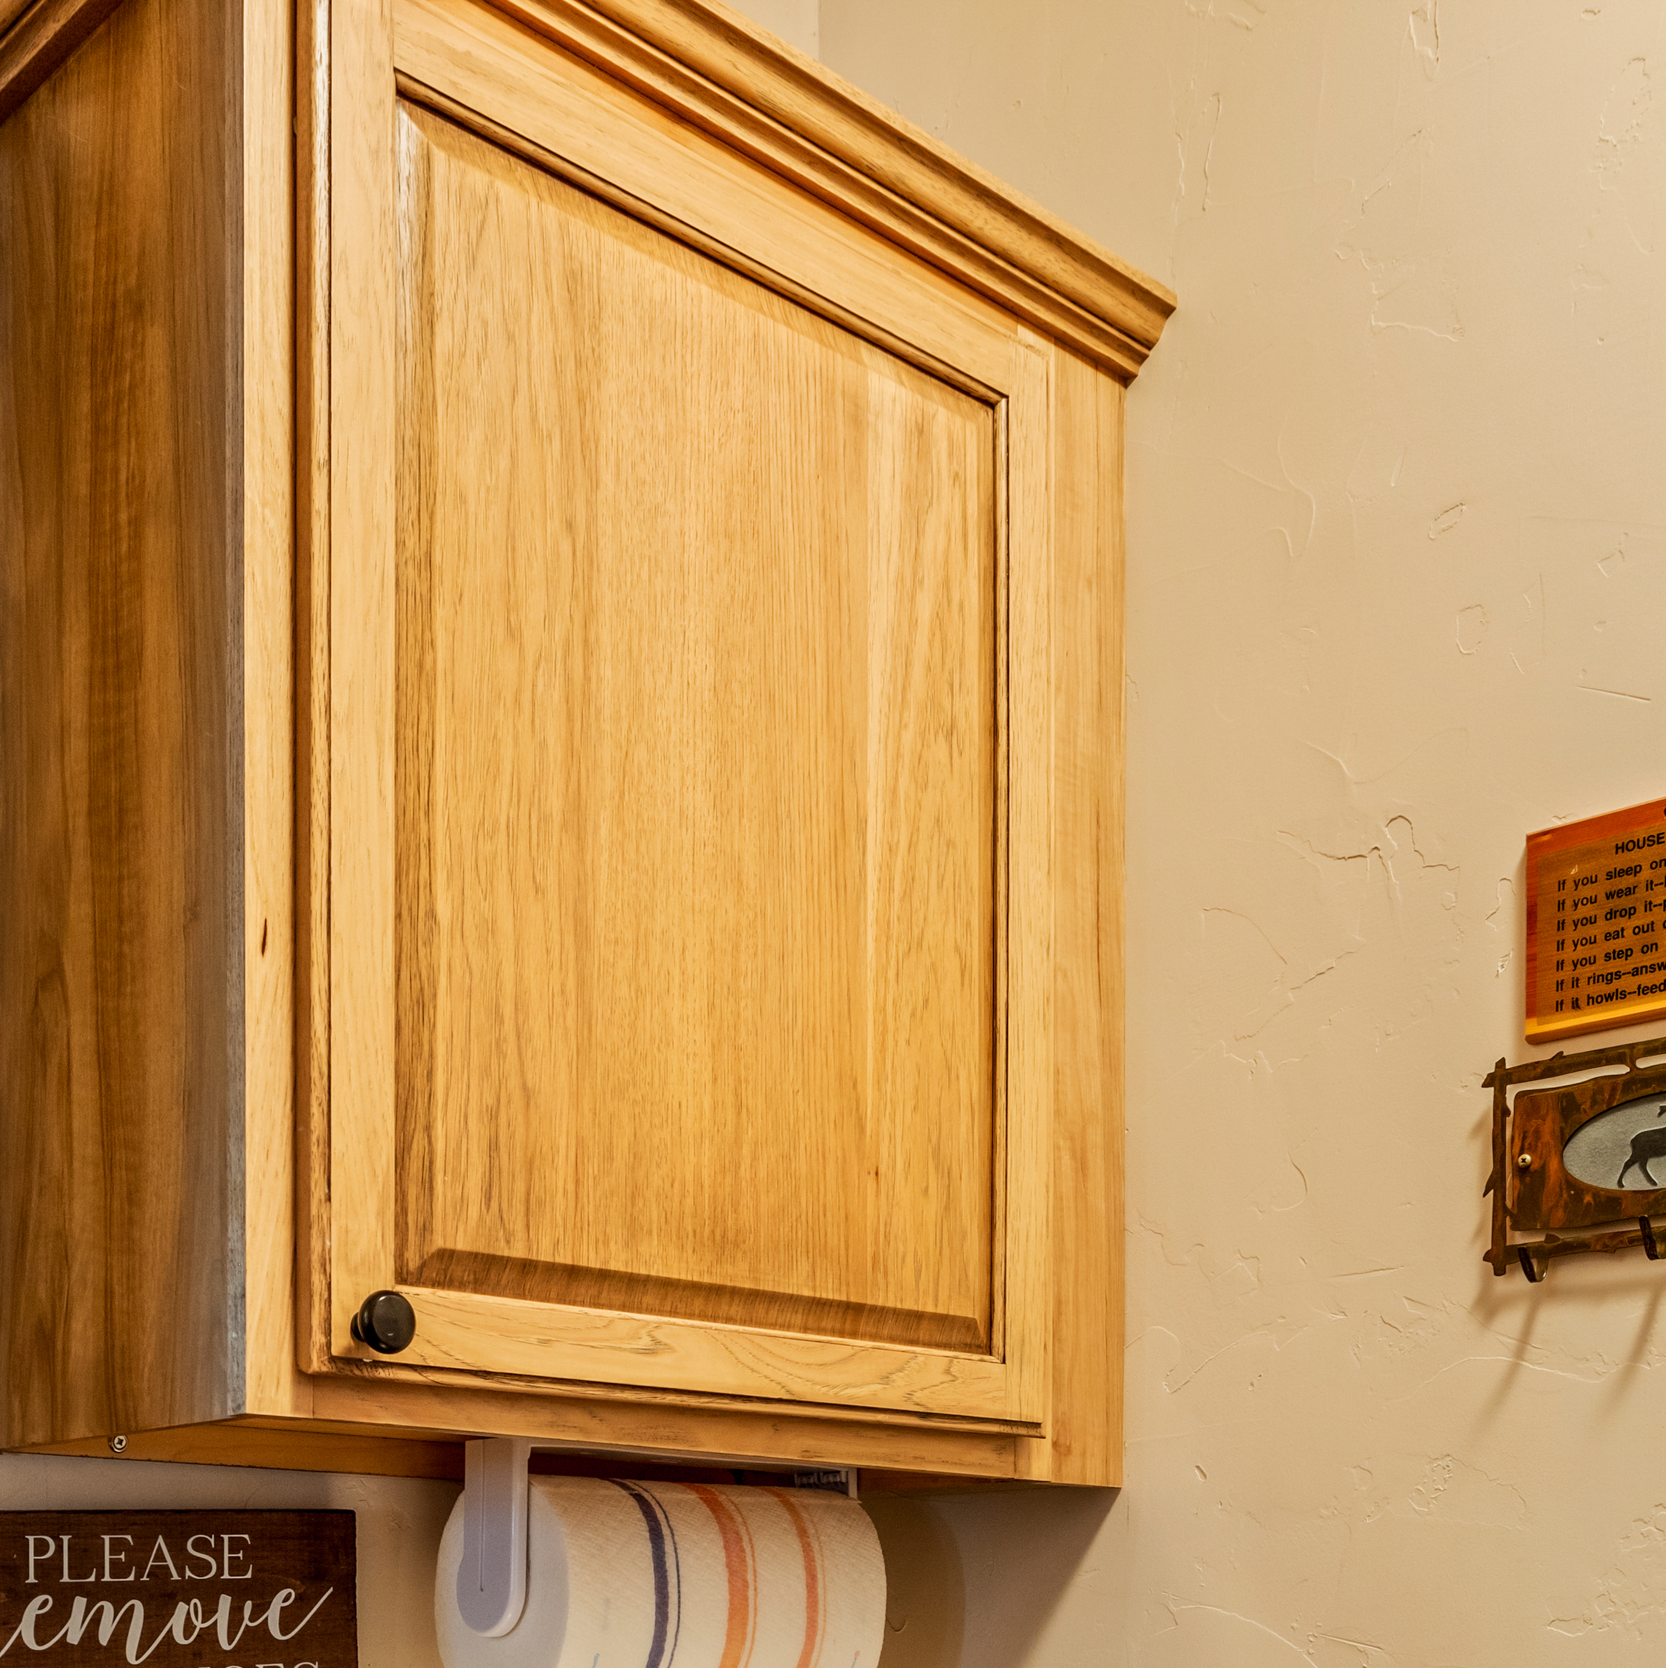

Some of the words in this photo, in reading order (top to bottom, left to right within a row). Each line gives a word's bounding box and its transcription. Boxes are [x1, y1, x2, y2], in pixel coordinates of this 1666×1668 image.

[1614, 831, 1666, 856] HOUSE
[1557, 878, 1567, 893] If
[1573, 874, 1598, 892] you
[1605, 863, 1643, 881] sleep
[1557, 898, 1566, 913] If
[1572, 894, 1598, 912] you
[1604, 884, 1639, 901] wear
[1556, 918, 1566, 932] If
[1572, 914, 1598, 932] you
[1604, 905, 1637, 922] drop
[1556, 938, 1566, 953] If
[1571, 934, 1597, 952] you
[1603, 926, 1626, 942] eat
[1632, 920, 1656, 936] out
[1555, 958, 1565, 973] If
[1571, 954, 1597, 972] you
[1603, 947, 1634, 963] step
[1640, 942, 1659, 955] on
[1555, 978, 1565, 993] If
[1571, 976, 1581, 989] it
[1555, 998, 1565, 1013] If
[1571, 996, 1582, 1011] it
[24, 1533, 254, 1584] PLEASE
